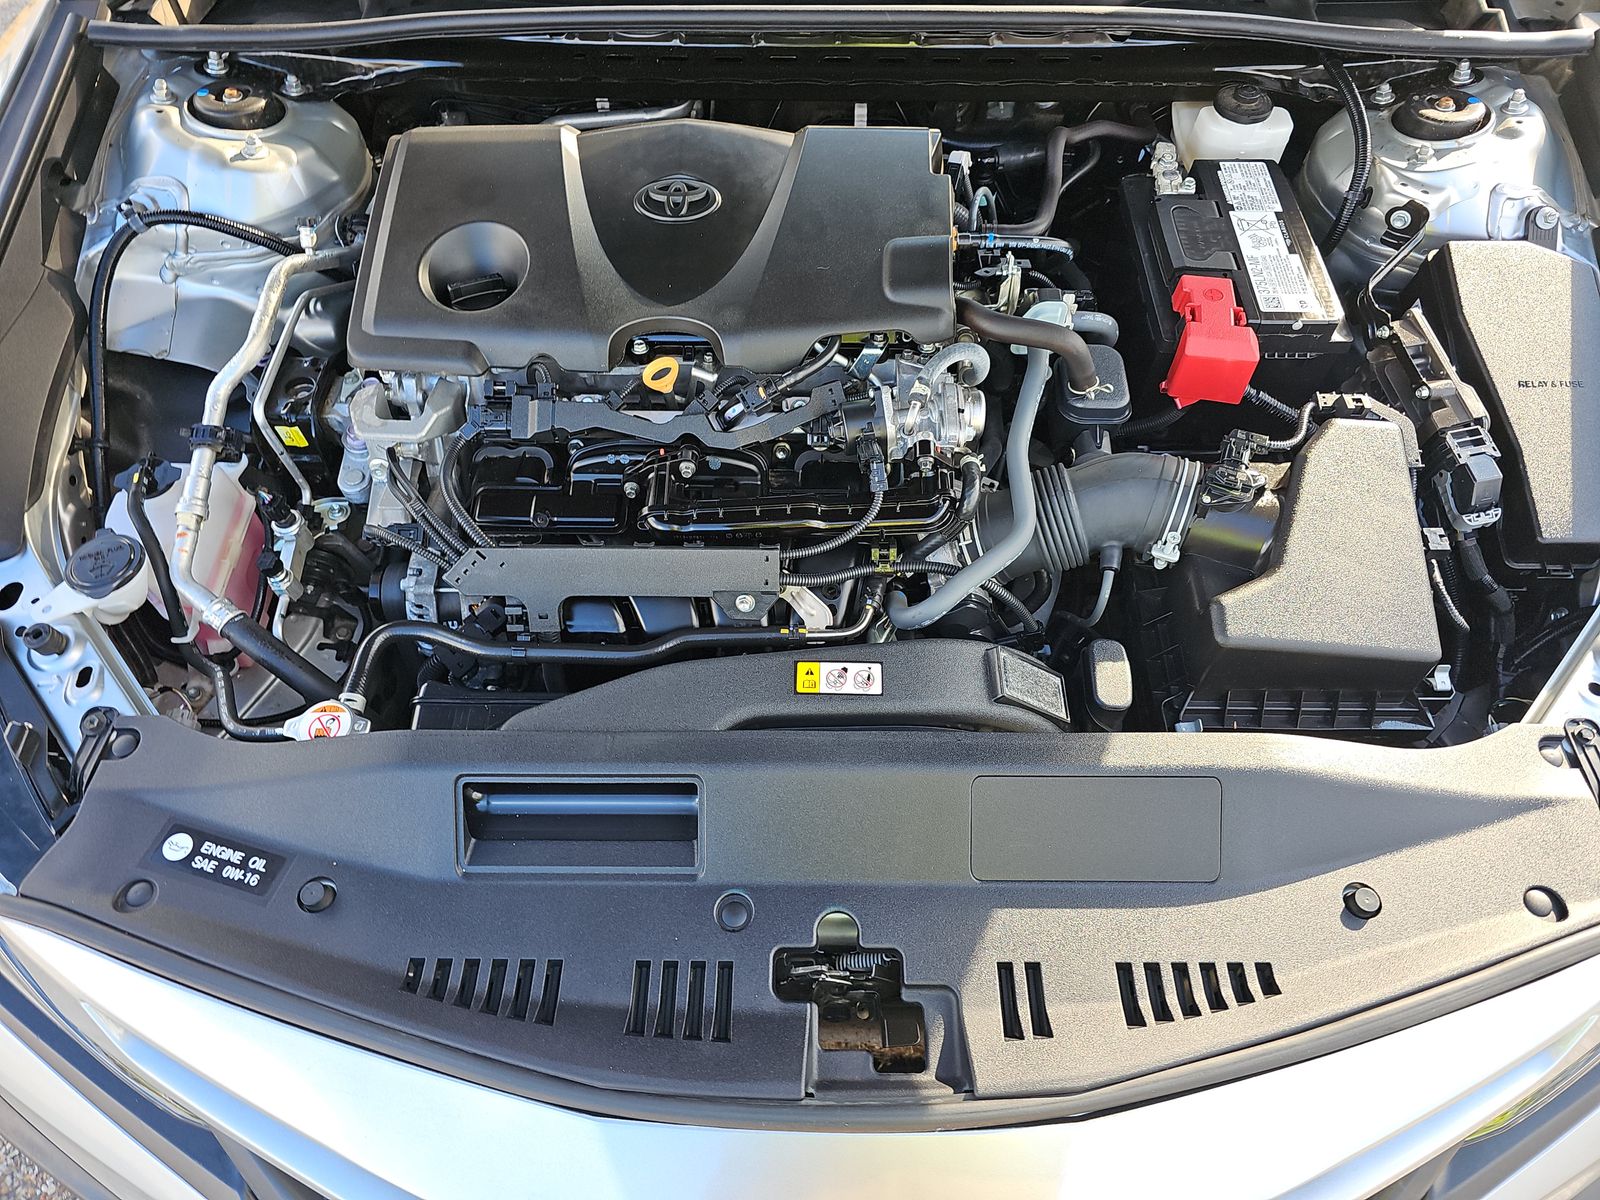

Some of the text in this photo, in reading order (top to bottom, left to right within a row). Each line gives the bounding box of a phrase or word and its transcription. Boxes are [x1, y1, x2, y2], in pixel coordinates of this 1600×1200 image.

[1279, 219, 1290, 240] CLARIOS
[1246, 254, 1271, 295] 375LN2-MF
[1518, 380, 1585, 388] RELAY & FUSE
[191, 855, 219, 874] SAE
[200, 840, 266, 873] ENGINE OIL
